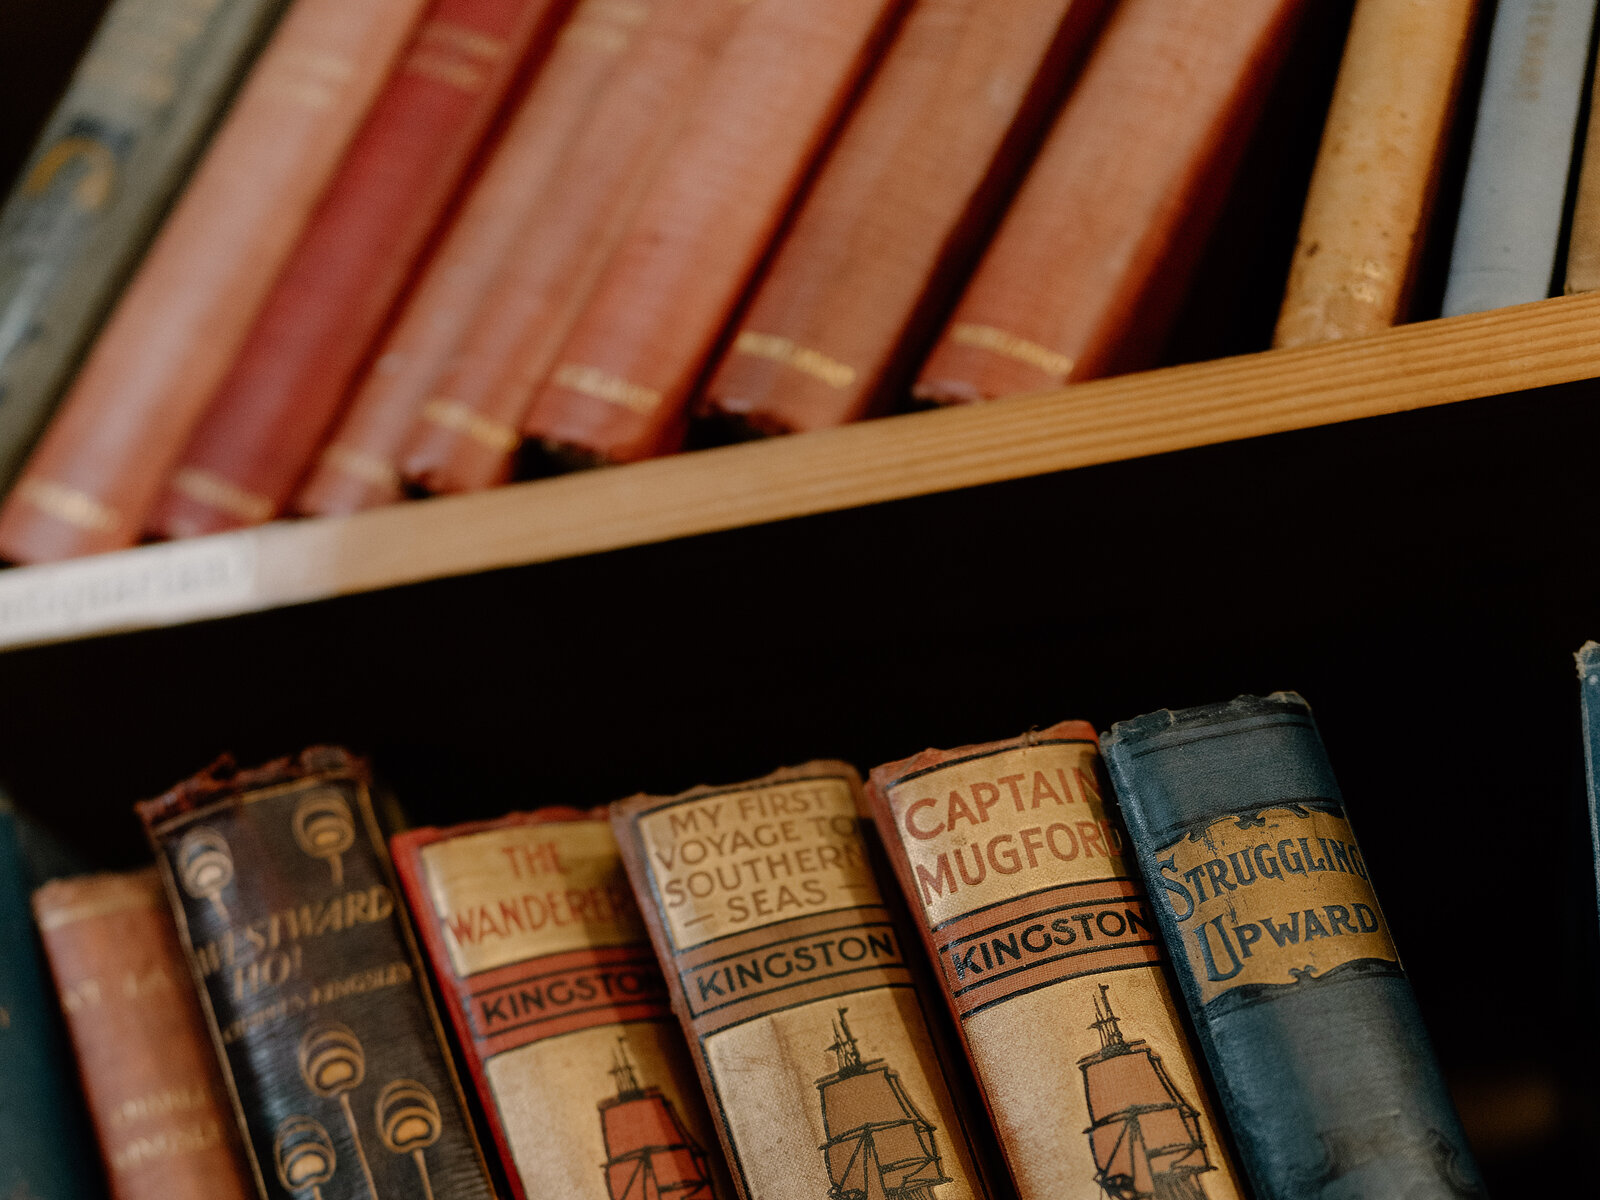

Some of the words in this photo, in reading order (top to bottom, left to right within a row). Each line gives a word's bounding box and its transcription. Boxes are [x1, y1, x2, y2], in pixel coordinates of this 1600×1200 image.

[668, 804, 723, 840] MY
[737, 787, 829, 822] FIRST
[904, 766, 1102, 840] CAPTAIN
[501, 842, 571, 877] THE
[655, 819, 803, 872] VOYAGE
[807, 814, 856, 837] TO
[726, 878, 829, 924] SEAS
[697, 932, 895, 1002] KINGSTON
[953, 908, 1153, 981] KINGSTON
[1193, 902, 1380, 982] UPWARD
